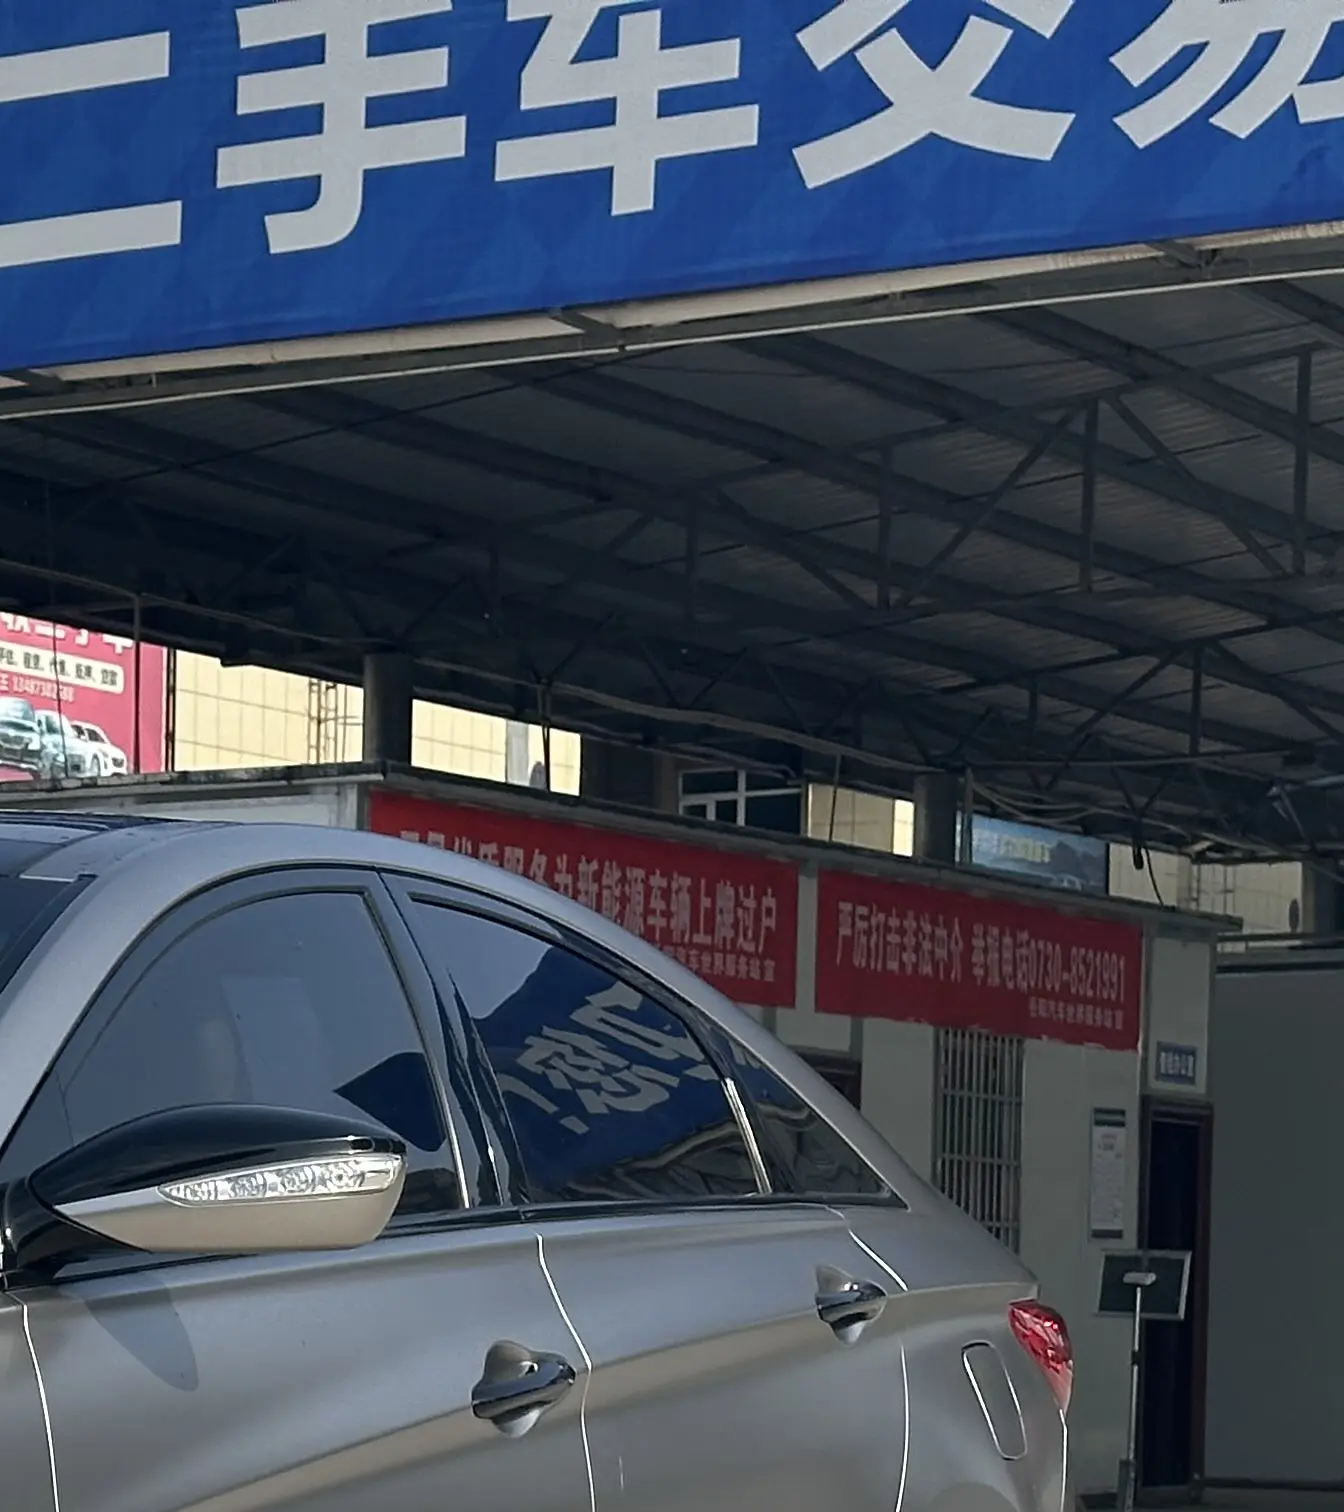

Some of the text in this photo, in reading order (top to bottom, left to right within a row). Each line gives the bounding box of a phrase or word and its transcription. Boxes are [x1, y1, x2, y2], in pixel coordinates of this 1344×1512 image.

[836, 900, 964, 983] 严厉打击非法中介
